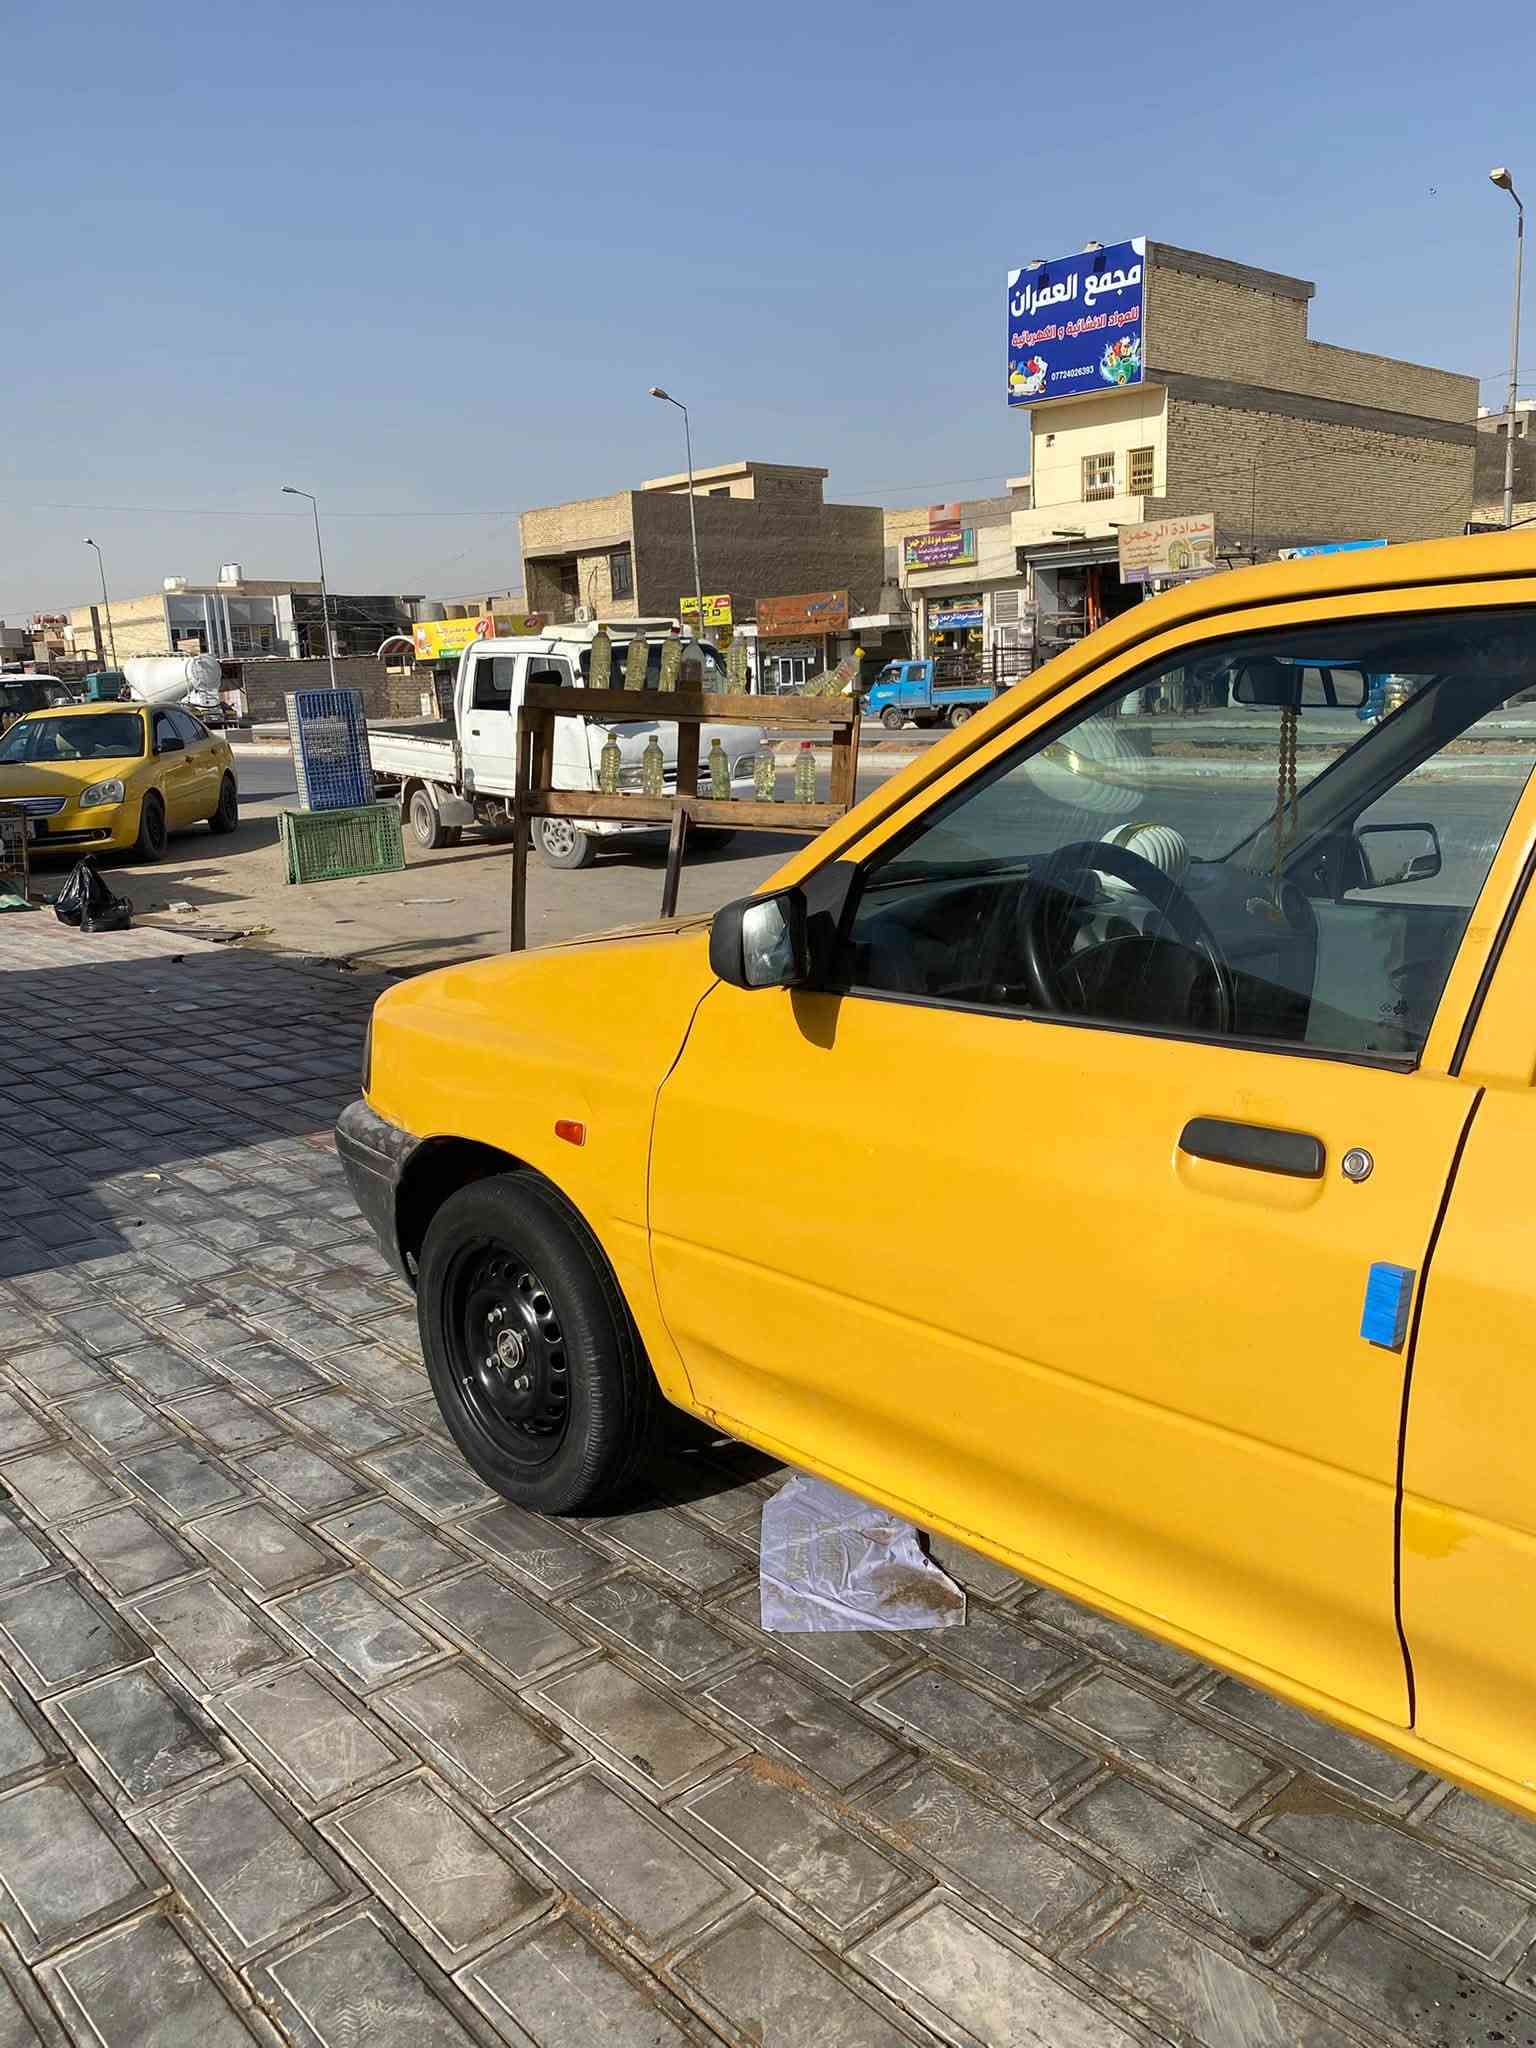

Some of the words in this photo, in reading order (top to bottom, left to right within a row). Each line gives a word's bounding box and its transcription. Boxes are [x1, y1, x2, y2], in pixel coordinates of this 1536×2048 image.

[1011, 273, 1078, 317] العمران
[1084, 264, 1141, 306] مجمع
[1107, 304, 1140, 328] للمواد
[1057, 327, 1065, 341] و
[1122, 525, 1168, 545] الرحمن
[1170, 521, 1210, 536] حدادة
